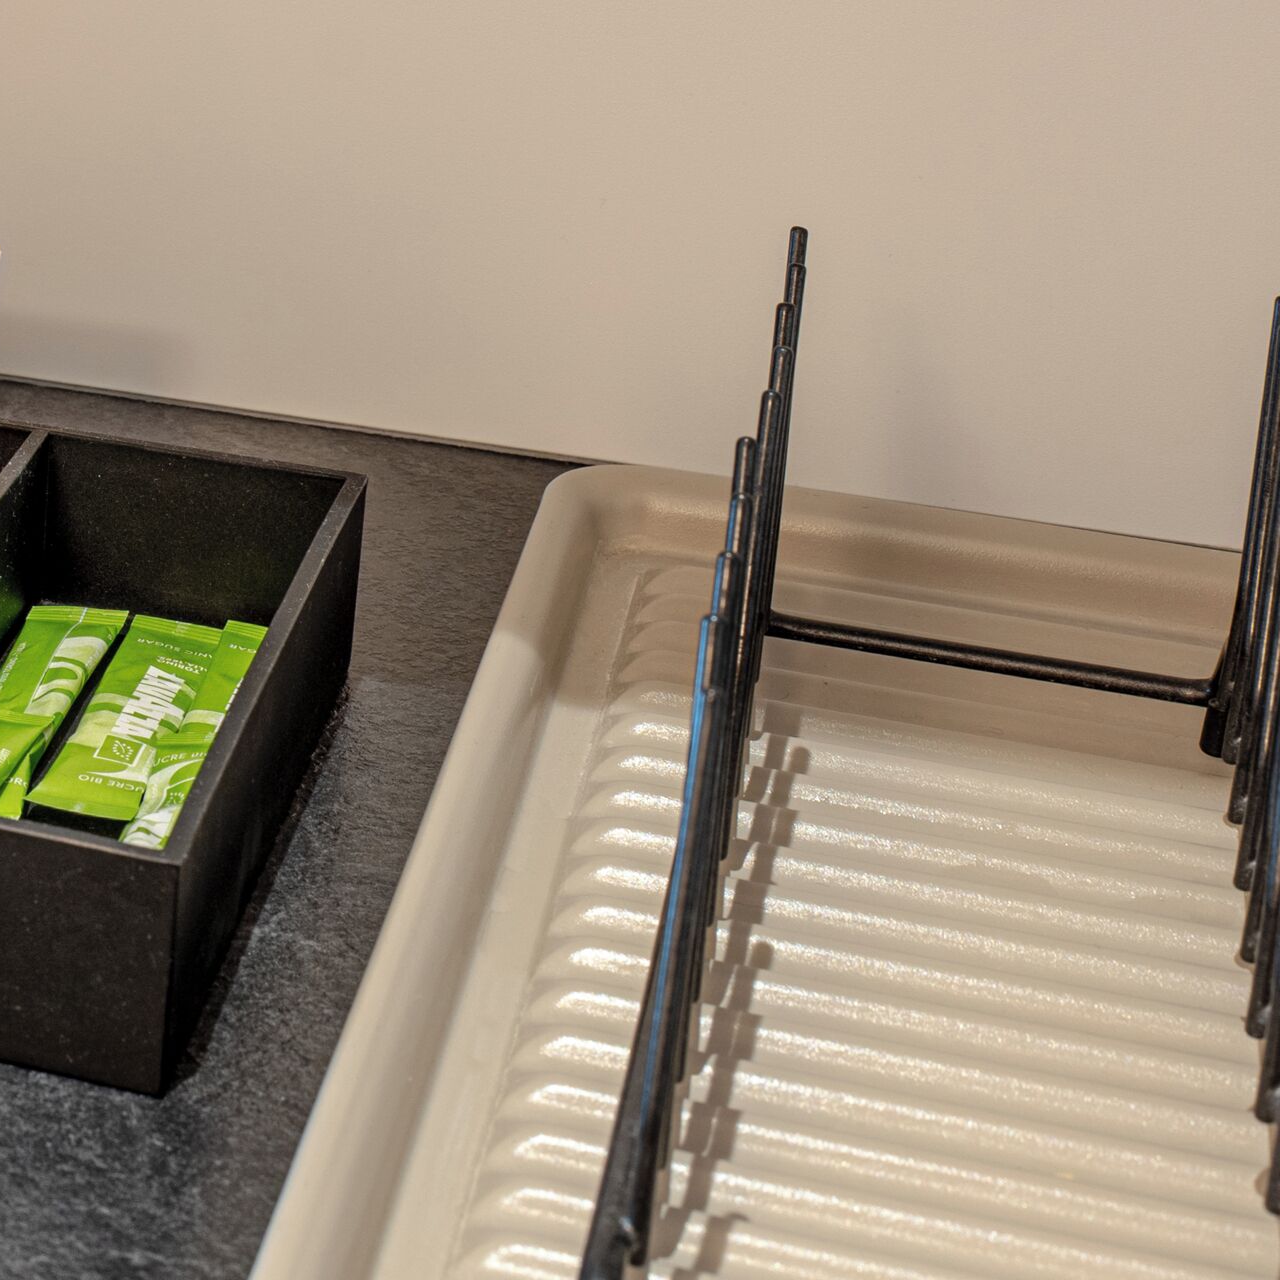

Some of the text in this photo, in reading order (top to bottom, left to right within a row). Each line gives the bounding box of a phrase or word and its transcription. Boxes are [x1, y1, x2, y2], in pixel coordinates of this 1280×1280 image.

[137, 638, 181, 652] SUGAR
[111, 665, 185, 739] LAVAZZA
[78, 774, 144, 794] UCRE BIO
